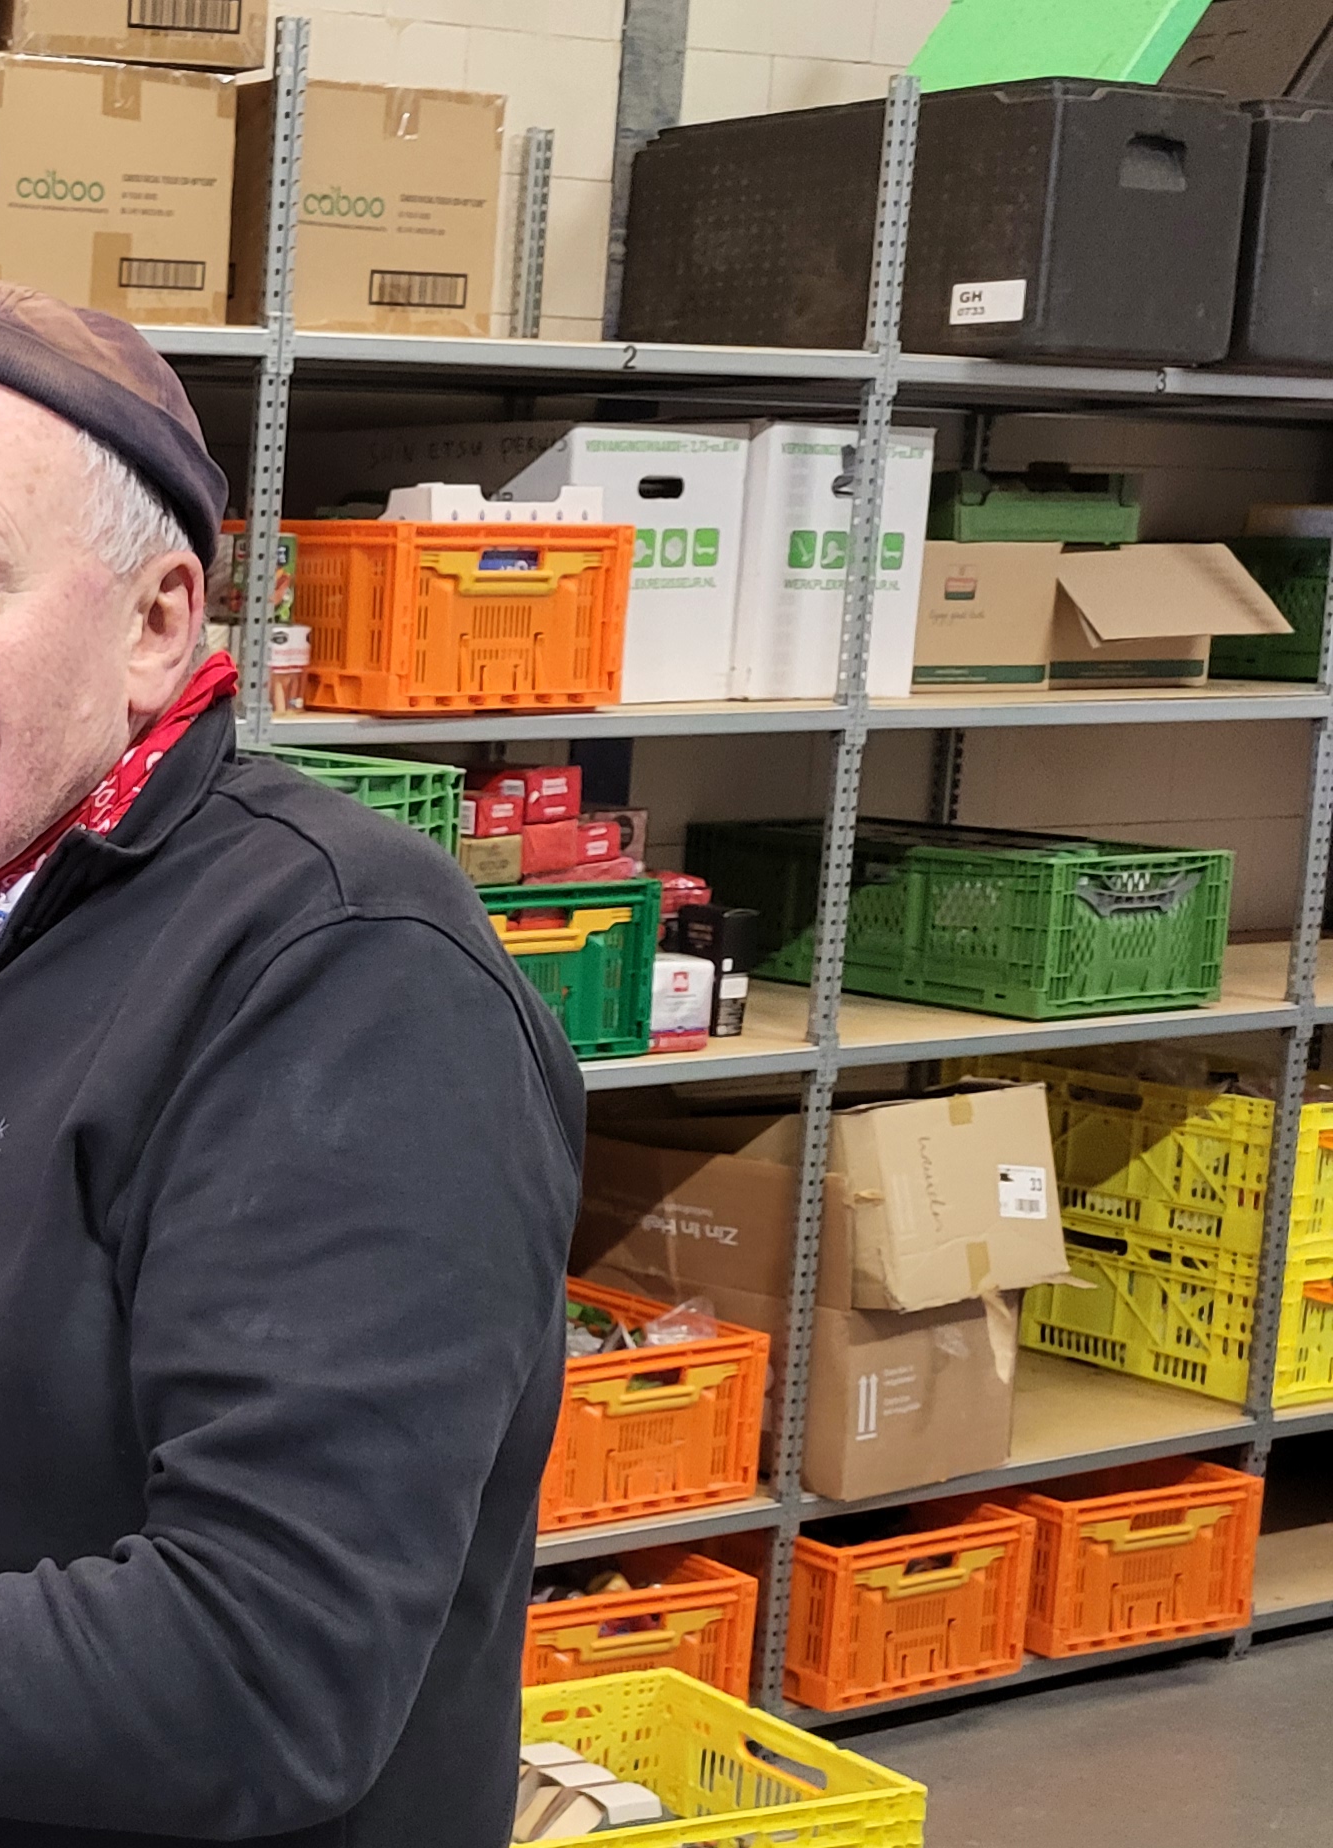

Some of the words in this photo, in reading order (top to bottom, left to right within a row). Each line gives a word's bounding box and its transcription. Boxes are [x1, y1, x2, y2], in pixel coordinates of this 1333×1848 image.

[16, 170, 106, 203] caboo
[303, 187, 385, 220] caboo
[959, 290, 983, 304] GH
[622, 345, 638, 370] 2
